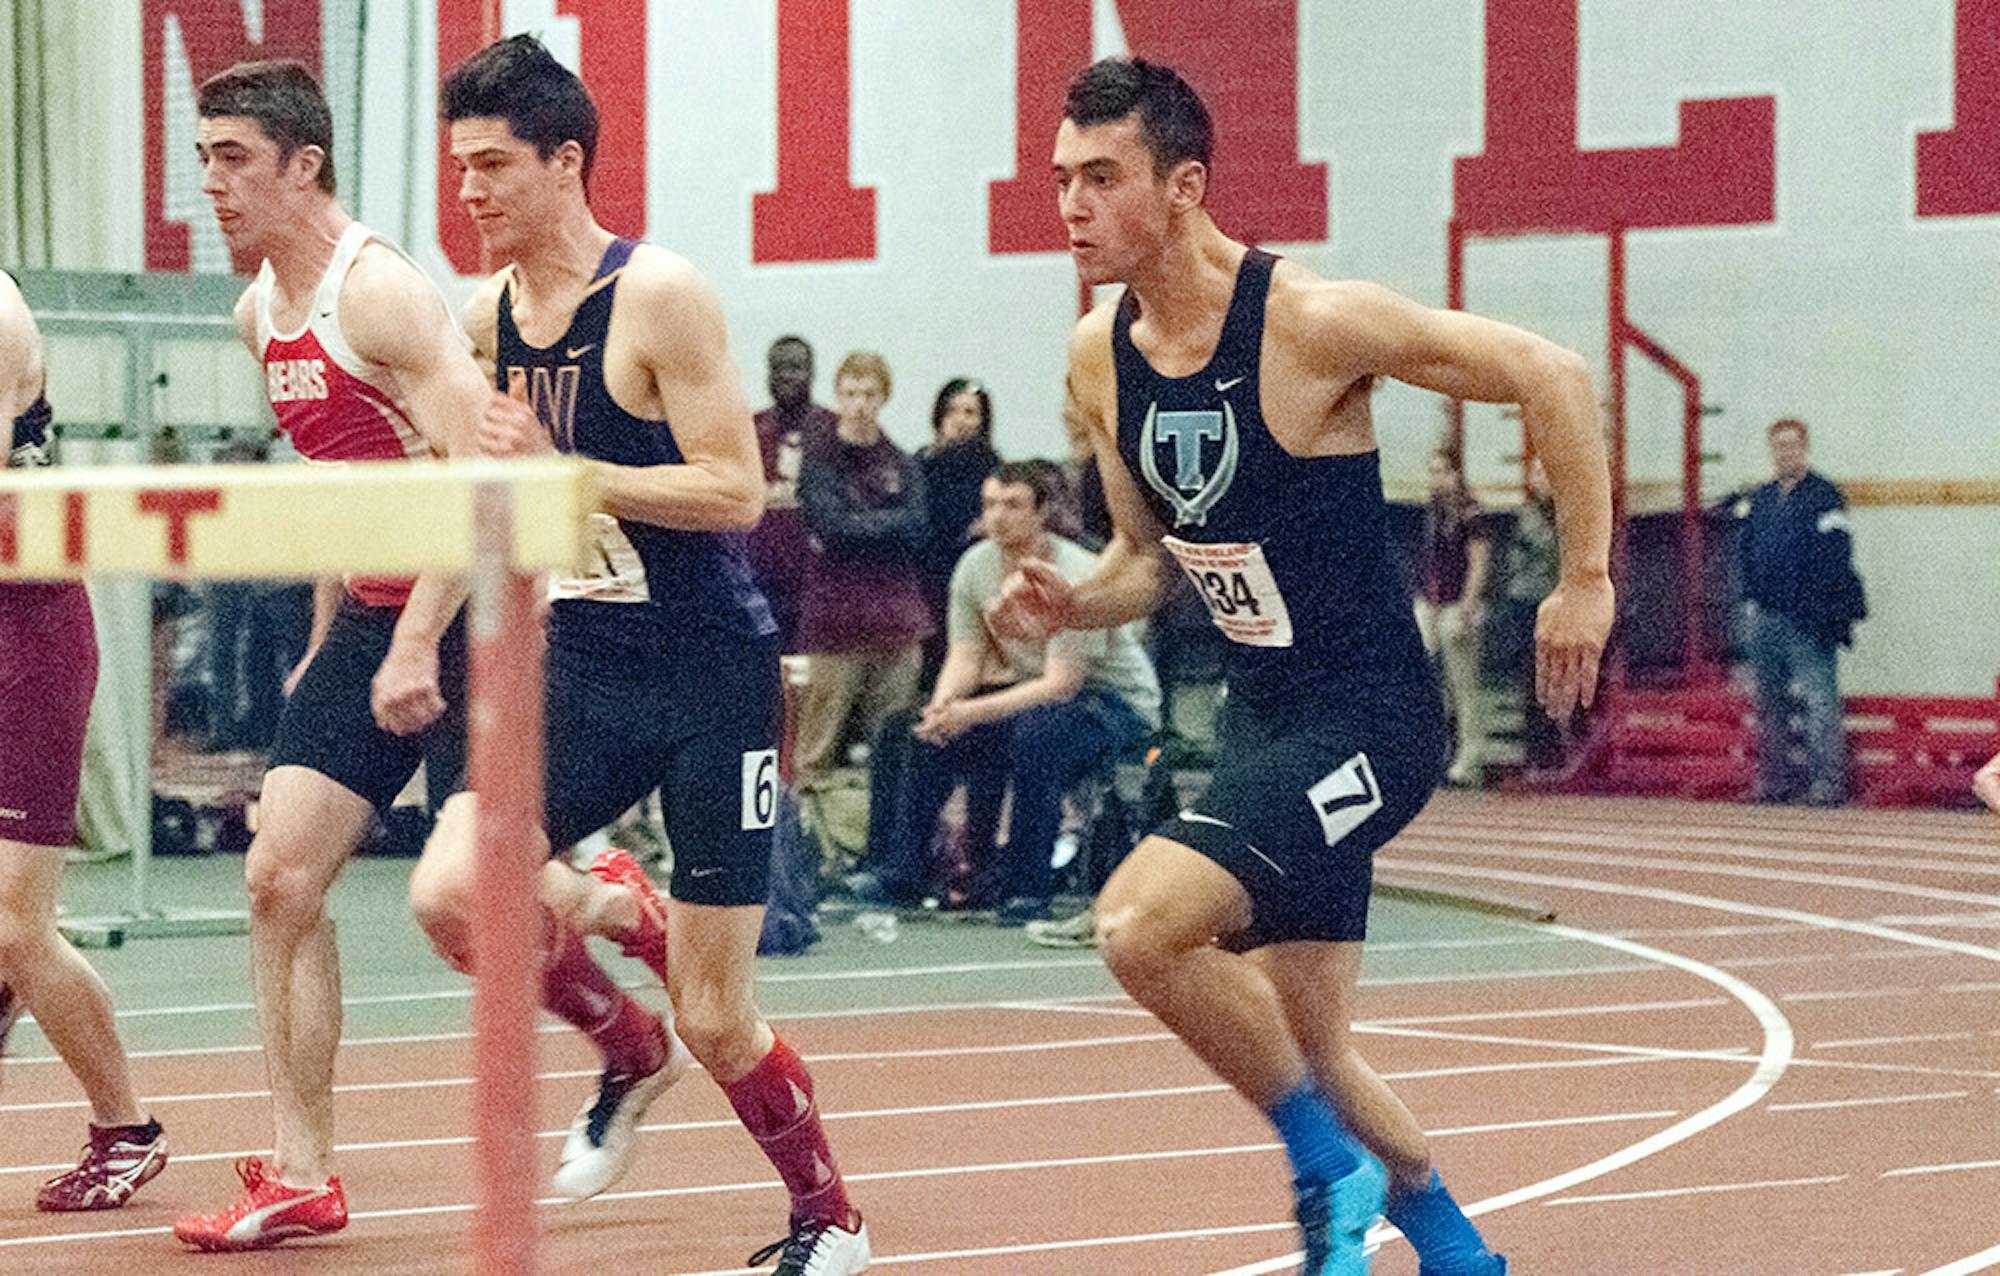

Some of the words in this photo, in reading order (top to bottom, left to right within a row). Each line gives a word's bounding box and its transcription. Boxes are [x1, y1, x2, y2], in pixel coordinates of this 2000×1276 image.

[267, 358, 328, 403] BEARS
[1156, 410, 1222, 490] T
[0, 487, 221, 564] IT
[755, 754, 773, 824] 6
[1321, 763, 1374, 816] 7
